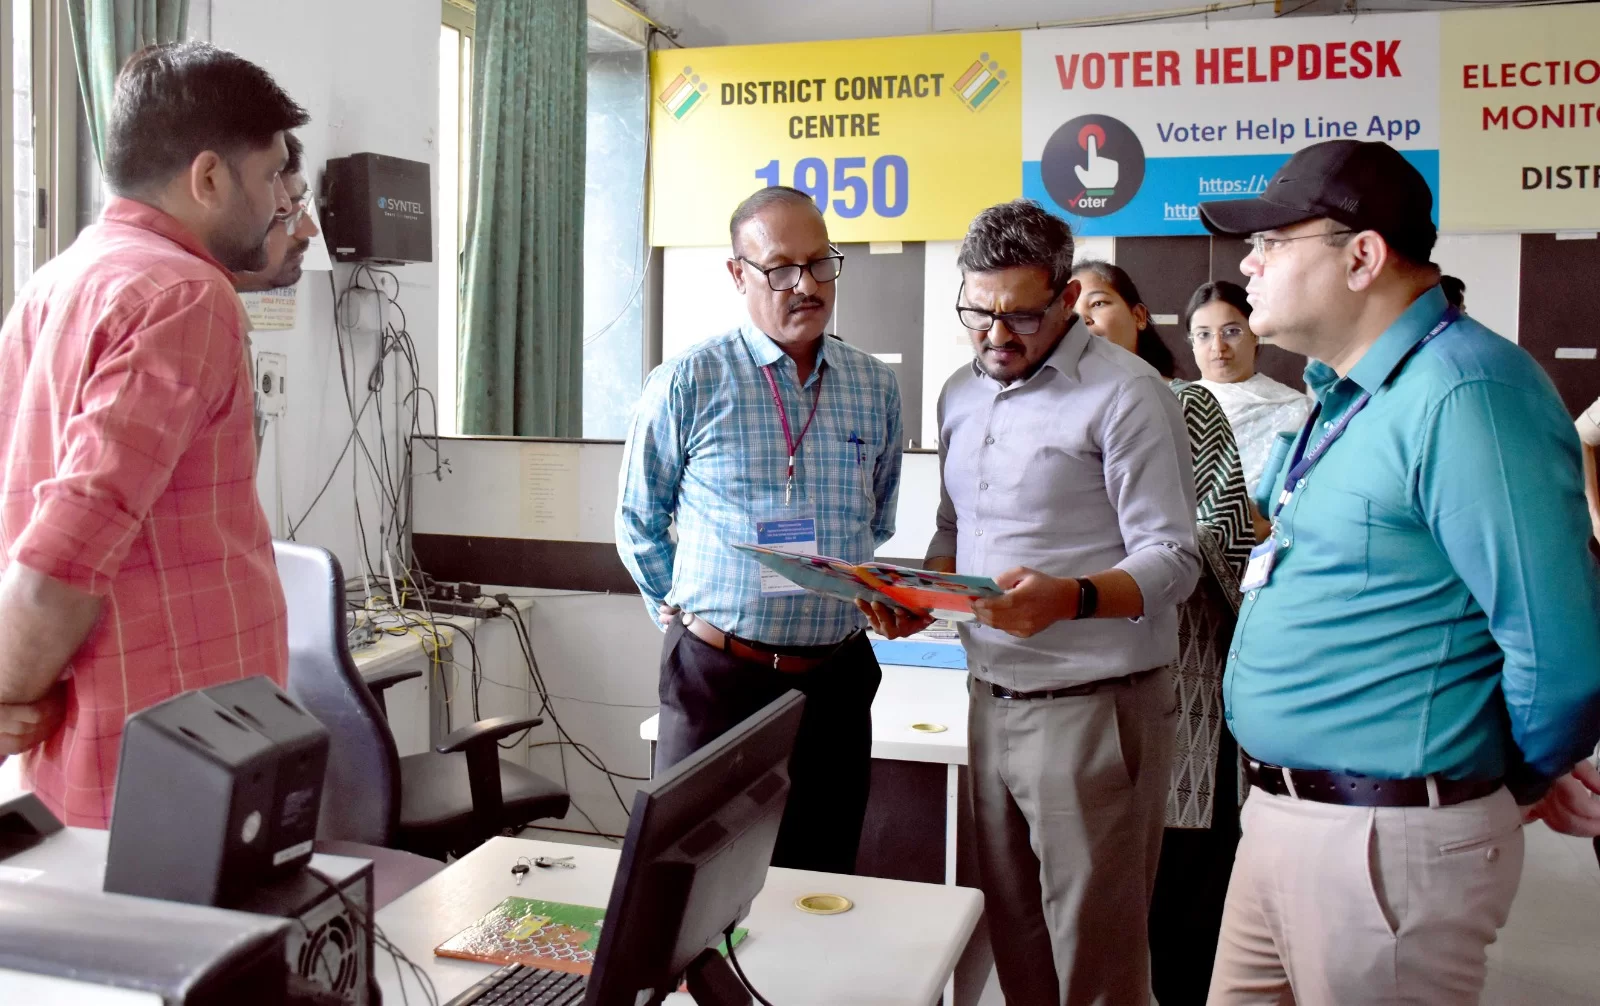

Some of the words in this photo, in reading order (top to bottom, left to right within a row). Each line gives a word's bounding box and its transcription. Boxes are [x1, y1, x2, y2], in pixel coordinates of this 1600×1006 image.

[1055, 50, 1181, 90] VOTER
[1195, 39, 1402, 86] HELPDESK
[1463, 59, 1600, 89] ELECTIO
[721, 78, 826, 106] DISTRICT
[835, 73, 945, 101] CONTACT
[788, 112, 880, 140] CENTRE
[1156, 122, 1227, 143] Voter
[1236, 117, 1295, 145] Help
[1305, 115, 1357, 139] Line
[1366, 114, 1421, 141] App
[387, 198, 424, 215] SYNTEL
